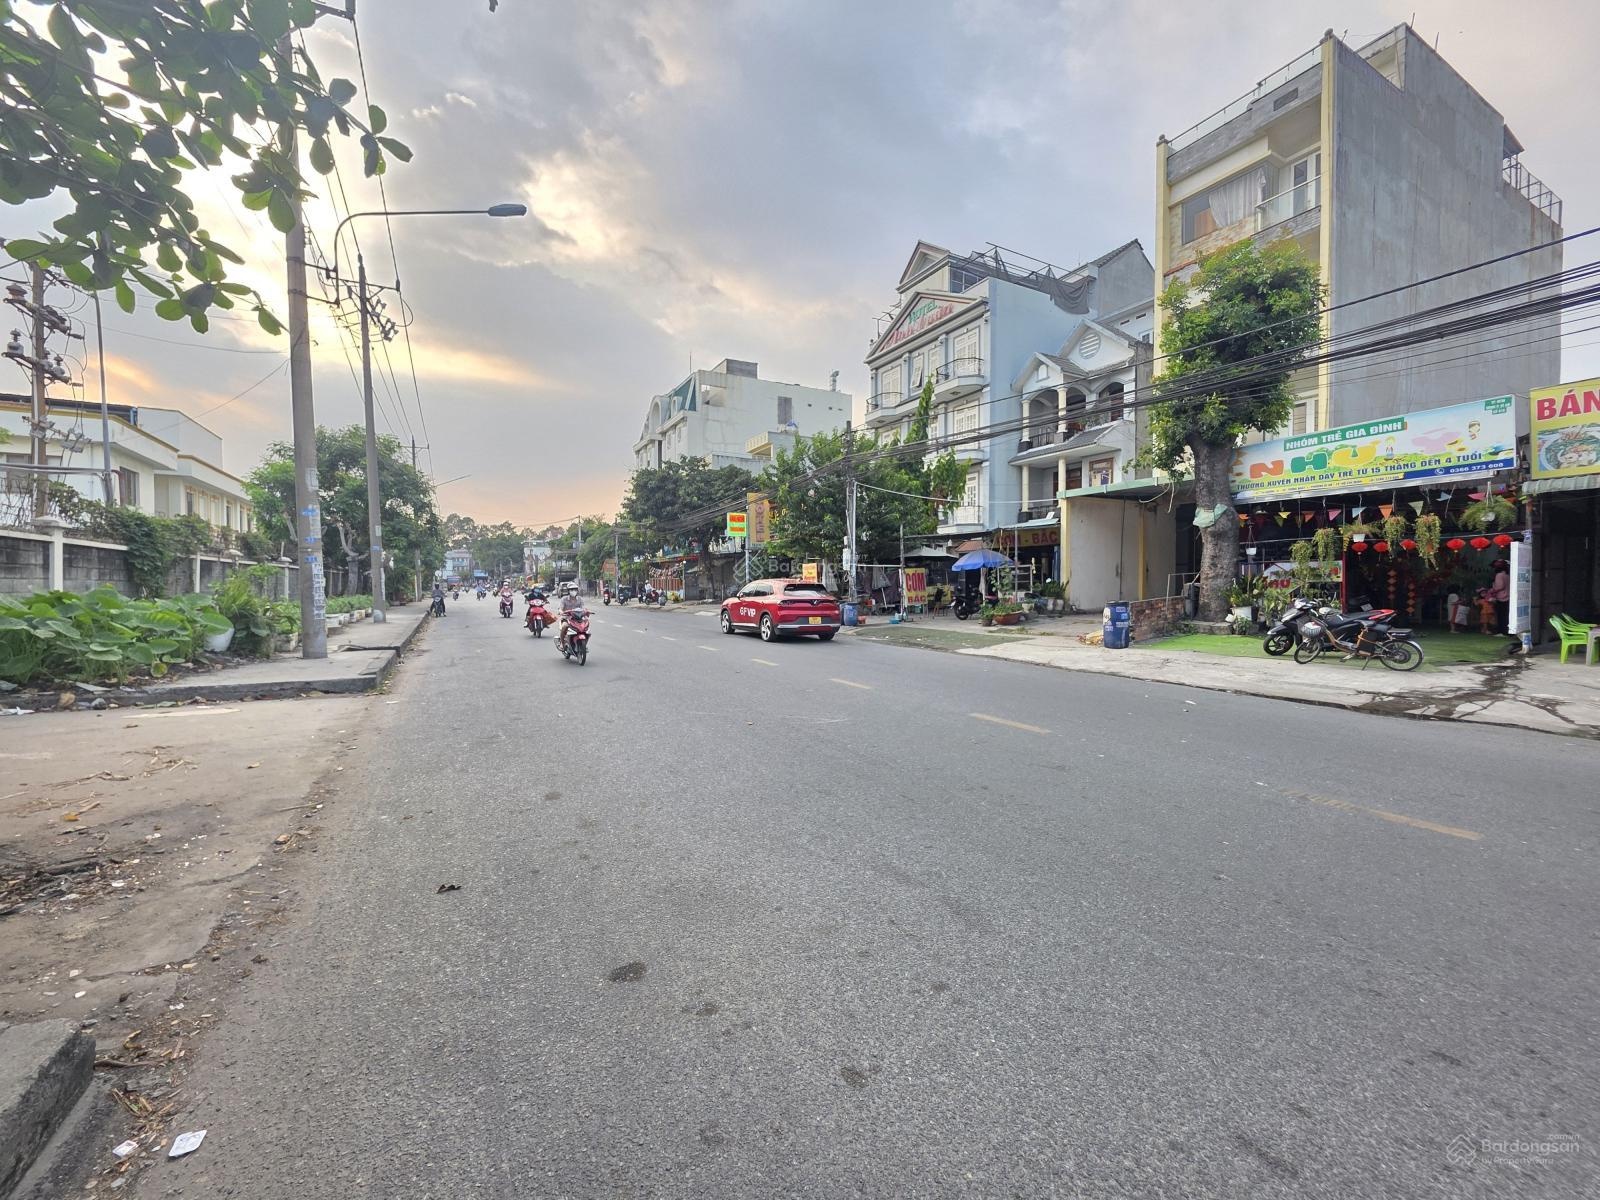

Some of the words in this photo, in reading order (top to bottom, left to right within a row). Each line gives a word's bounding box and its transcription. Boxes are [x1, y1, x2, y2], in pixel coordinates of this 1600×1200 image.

[1286, 437, 1318, 450] NHÓM
[1345, 428, 1366, 439] GIA
[1370, 421, 1402, 434] ĐÌNH
[1371, 466, 1381, 474] 15
[1444, 456, 1452, 464] 4
